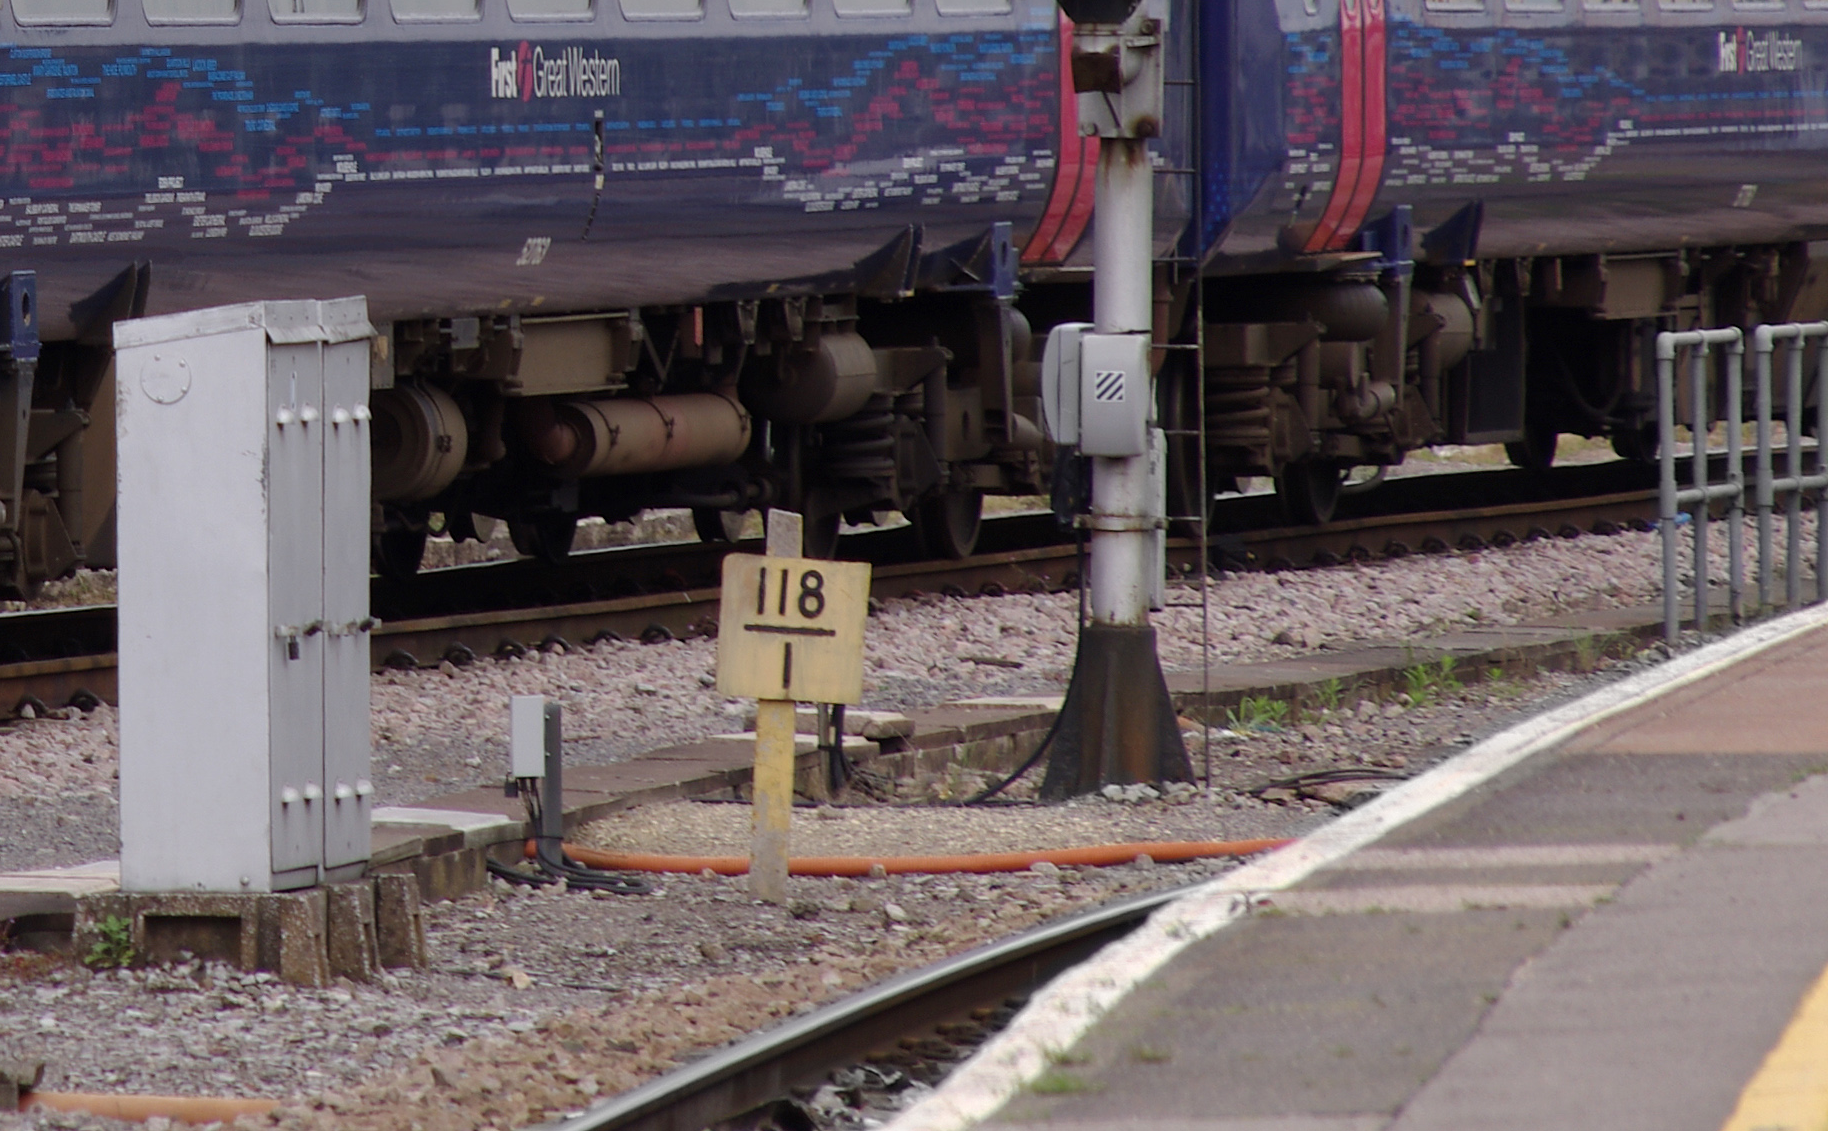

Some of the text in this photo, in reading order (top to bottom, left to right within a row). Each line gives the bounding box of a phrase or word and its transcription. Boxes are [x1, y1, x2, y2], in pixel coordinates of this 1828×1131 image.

[491, 45, 620, 99] First Great Western
[1746, 30, 1769, 72] Great
[1769, 30, 1802, 71] Western
[757, 567, 825, 619] 118
[783, 642, 792, 689] 1
